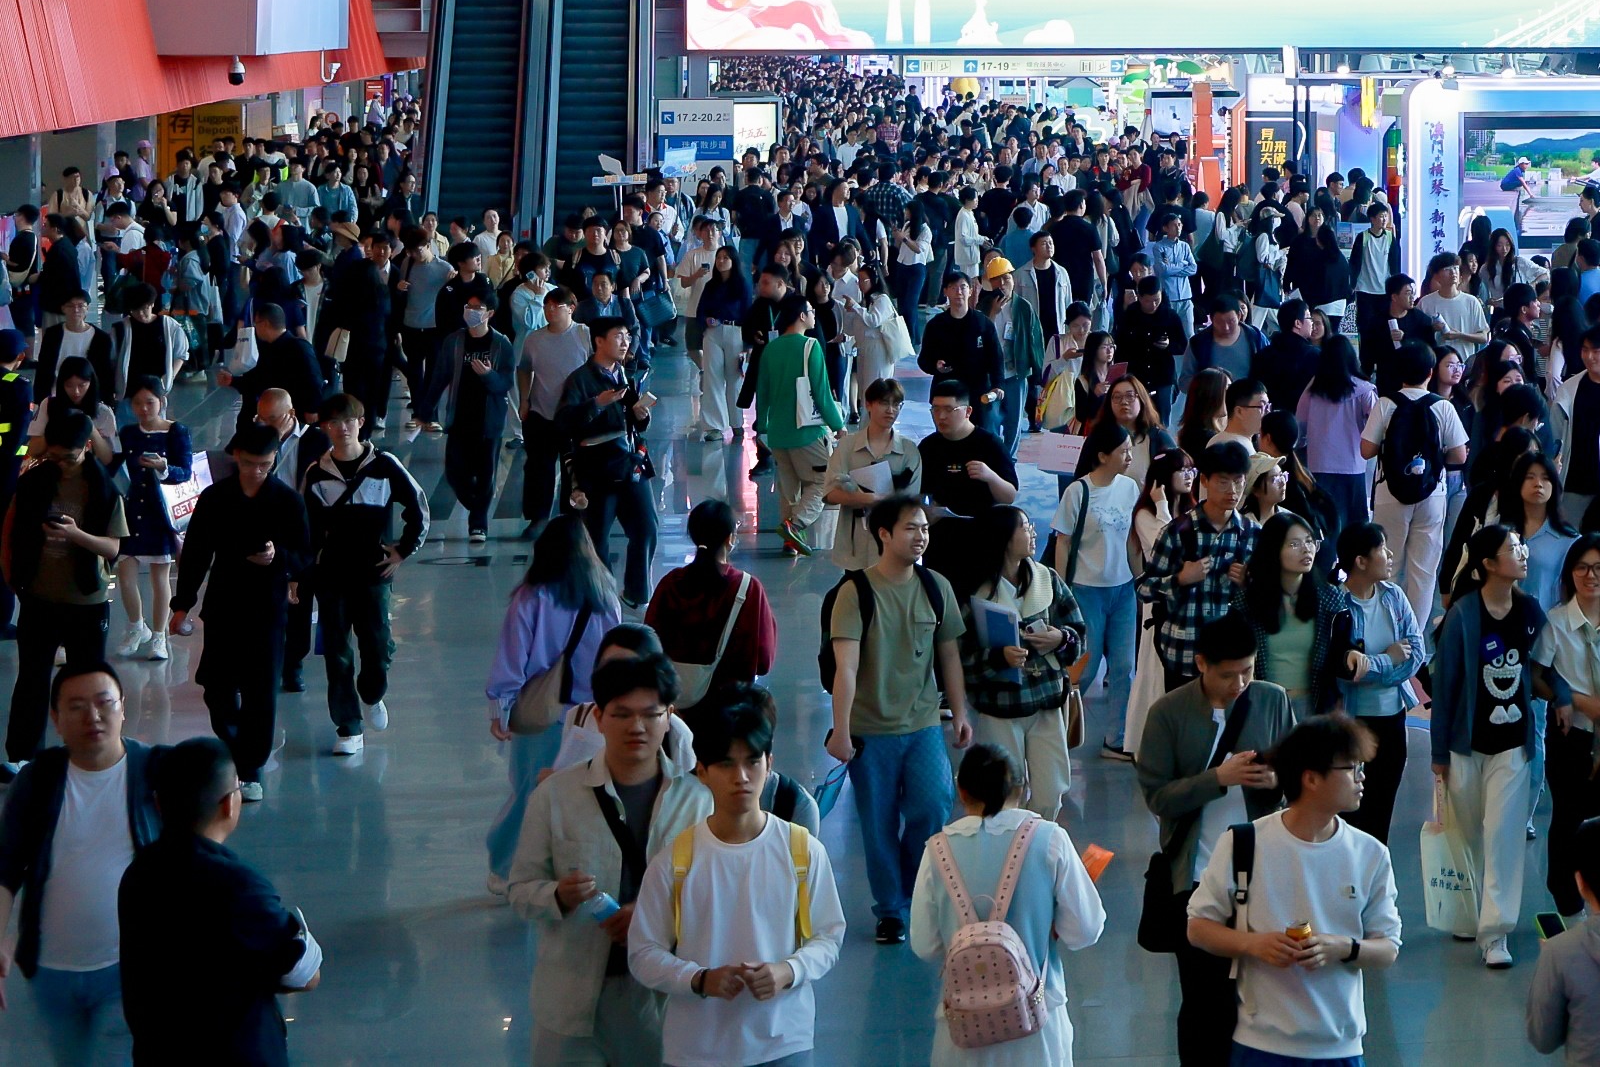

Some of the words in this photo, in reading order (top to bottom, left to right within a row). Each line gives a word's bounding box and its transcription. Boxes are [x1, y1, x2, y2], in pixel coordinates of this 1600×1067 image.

[981, 61, 1010, 71] 17-19
[197, 114, 239, 125] Luggage
[676, 113, 722, 122] 17.2-20.2
[198, 125, 239, 136] Deposit
[173, 501, 191, 517] GET
